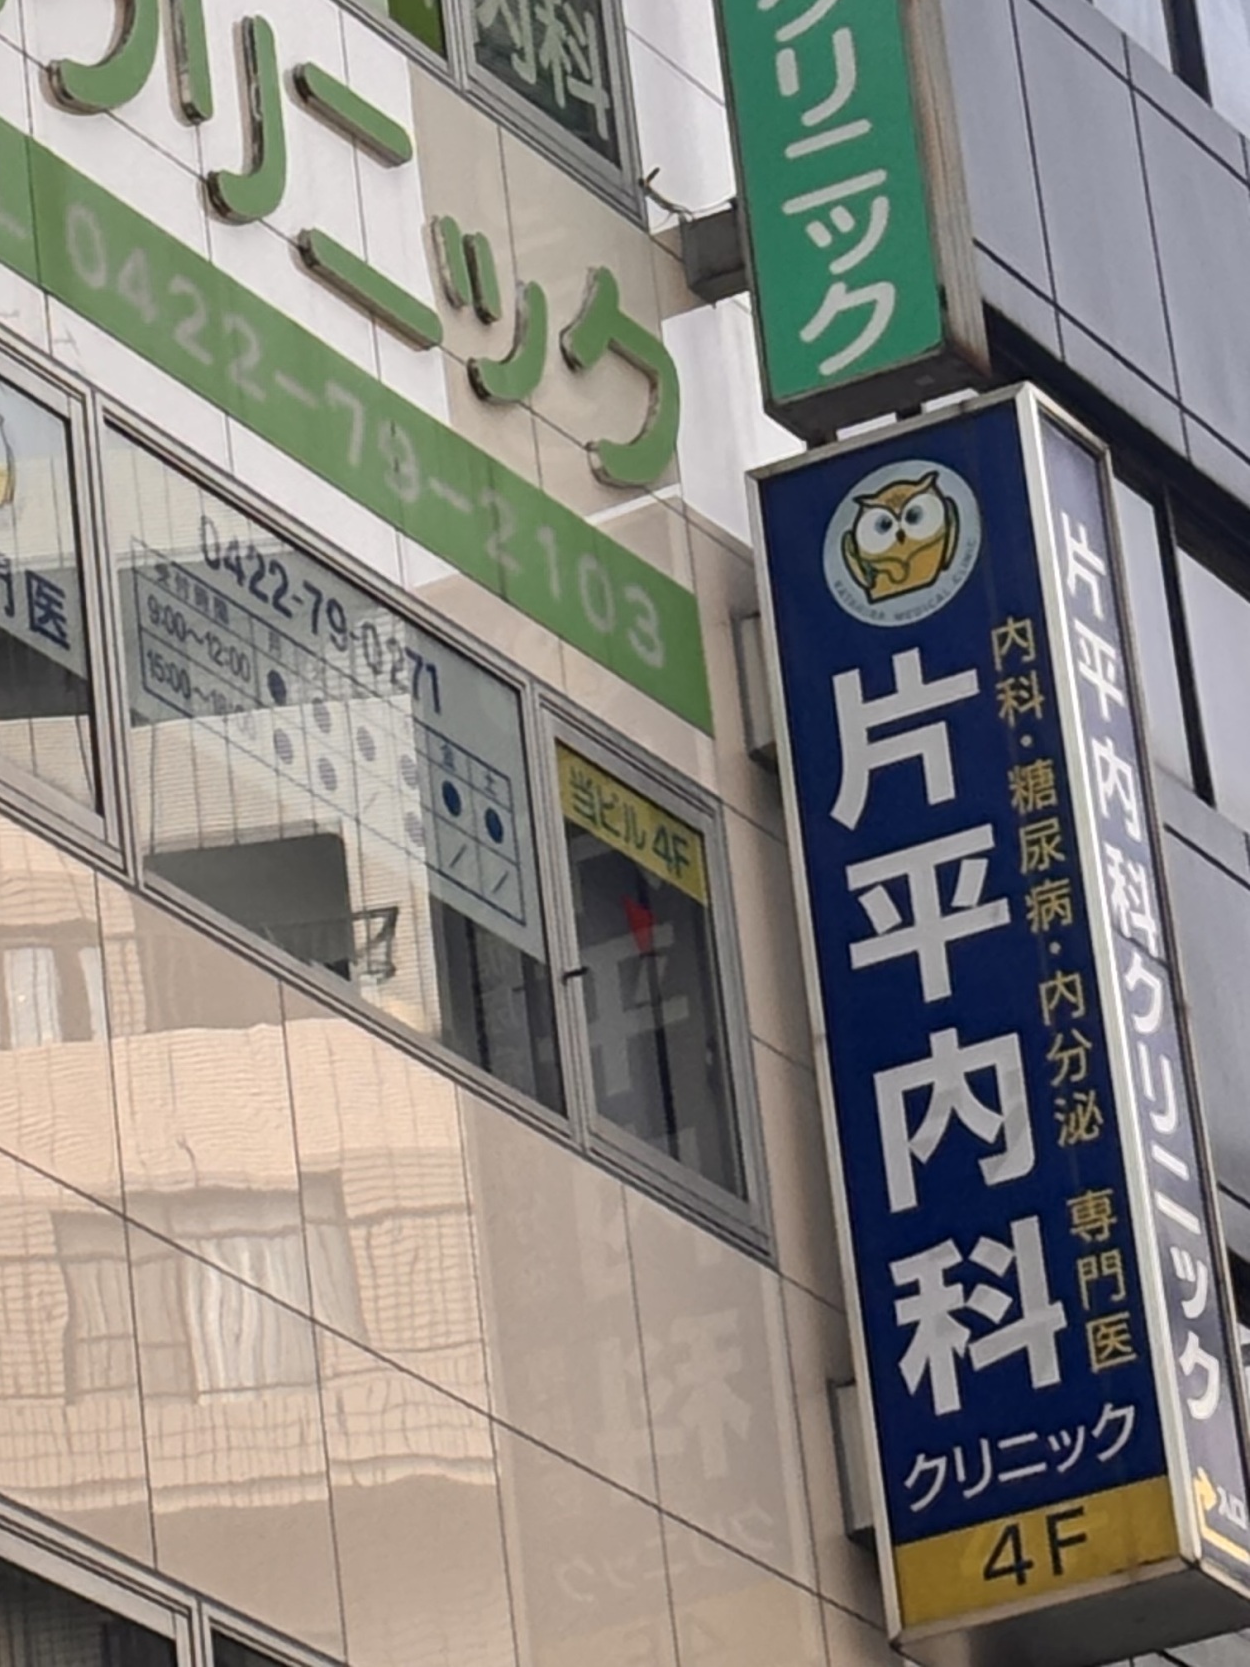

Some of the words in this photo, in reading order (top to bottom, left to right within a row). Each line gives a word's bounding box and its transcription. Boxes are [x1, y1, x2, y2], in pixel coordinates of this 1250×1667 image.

[830, 645, 1069, 1417] 片平内科
[990, 616, 1106, 1148] 内科・糖尿病・内分泌
[1066, 1186, 1138, 1374] 専門医
[1058, 509, 1221, 1421] 片平内科クリニック
[904, 1401, 1136, 1512] クリニック
